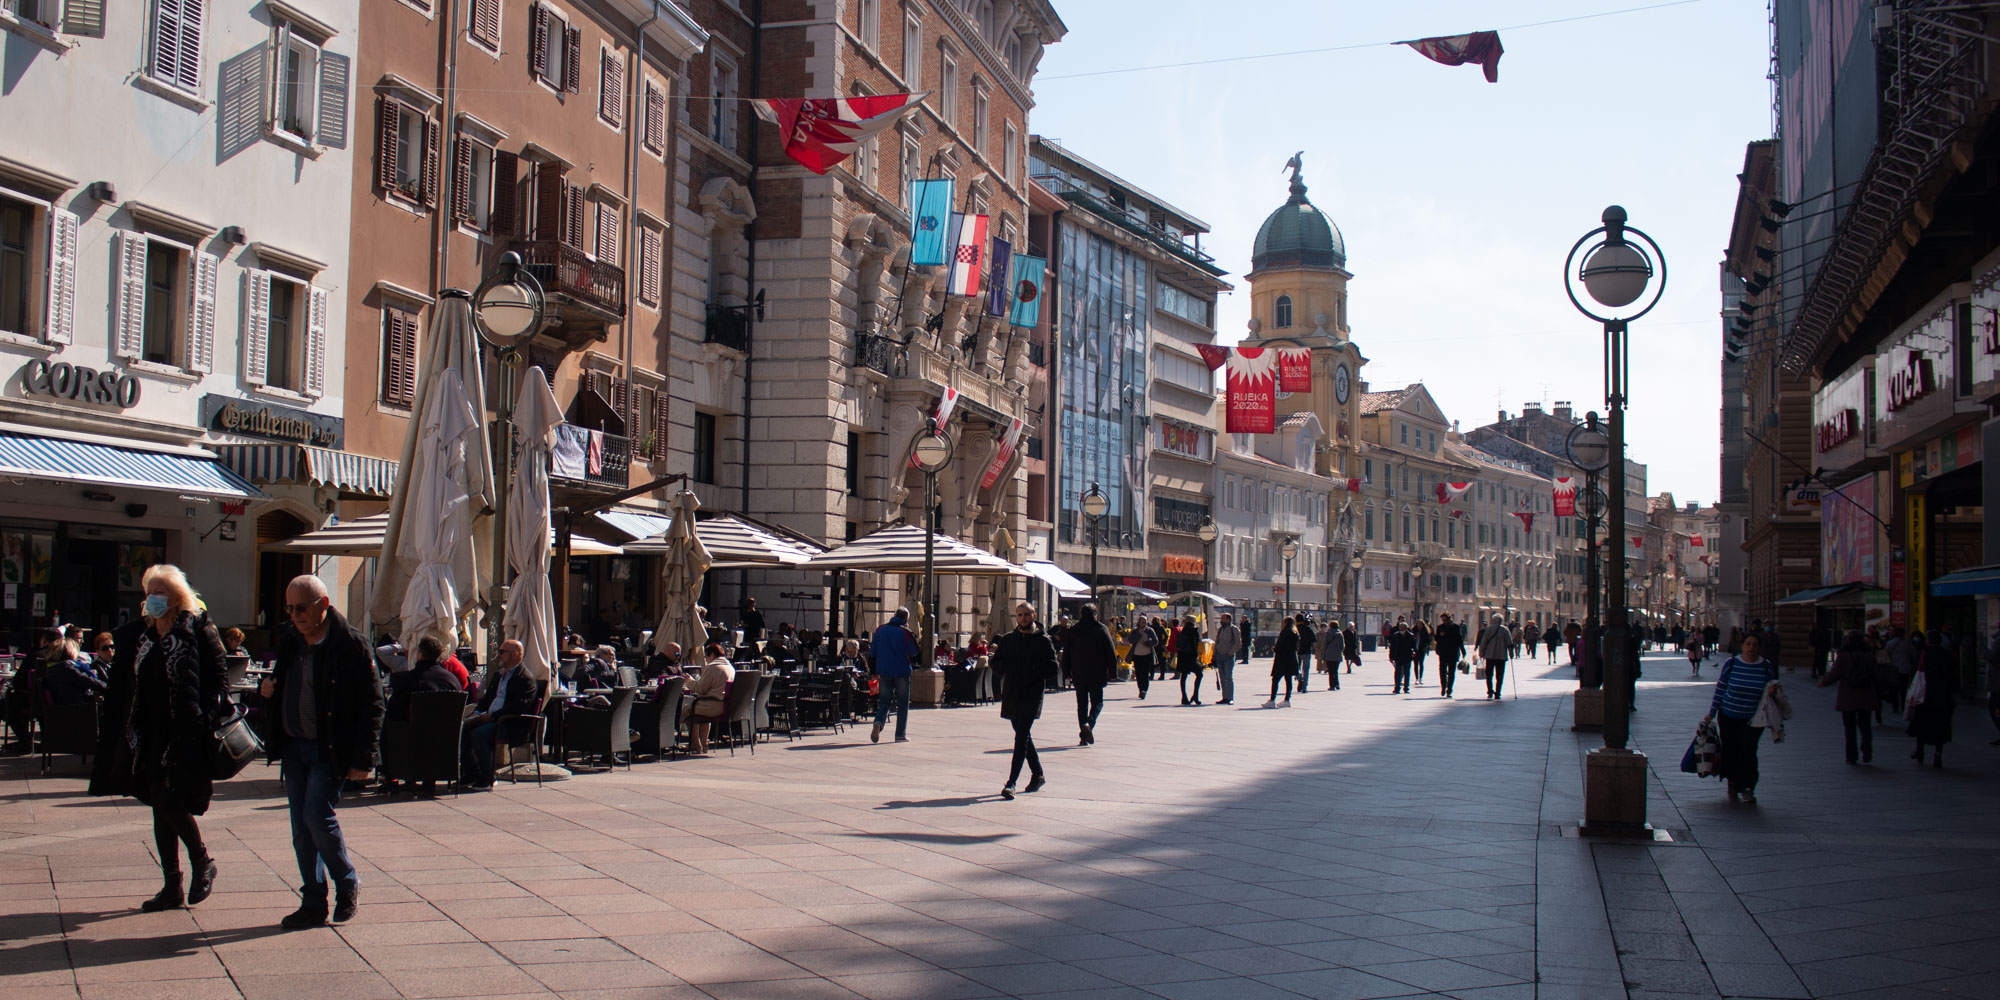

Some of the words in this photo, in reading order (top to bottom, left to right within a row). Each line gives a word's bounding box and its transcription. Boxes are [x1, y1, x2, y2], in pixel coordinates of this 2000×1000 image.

[24, 358, 142, 409] CORSO
[1233, 392, 1268, 402] RIJEKA
[220, 400, 313, 441] Gentleman
[1797, 487, 1819, 500] dm
[1163, 554, 1204, 575] KORZO
